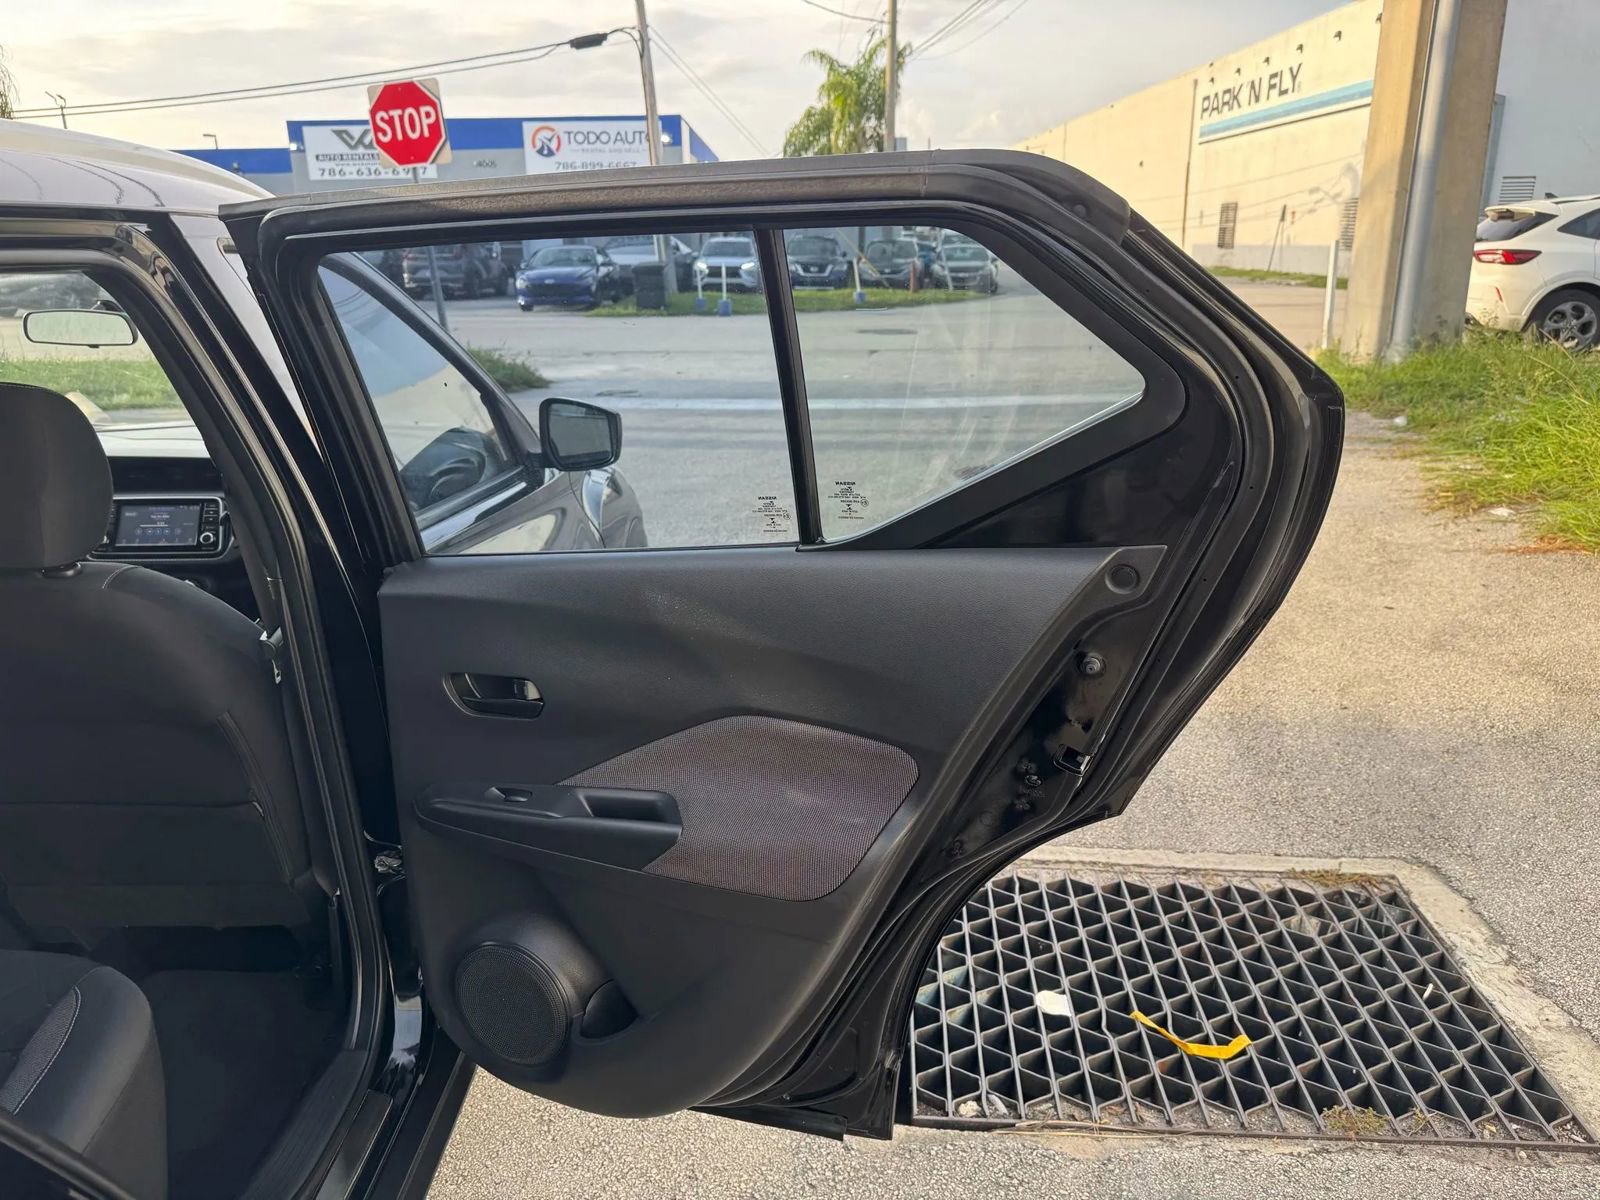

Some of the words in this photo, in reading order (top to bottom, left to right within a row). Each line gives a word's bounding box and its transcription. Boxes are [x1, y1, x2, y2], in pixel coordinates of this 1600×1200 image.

[1200, 83, 1243, 120] PARK
[1266, 62, 1303, 101] FLY
[375, 105, 436, 143] STOP
[564, 131, 611, 145] TODO
[319, 167, 428, 177] 786-636-697
